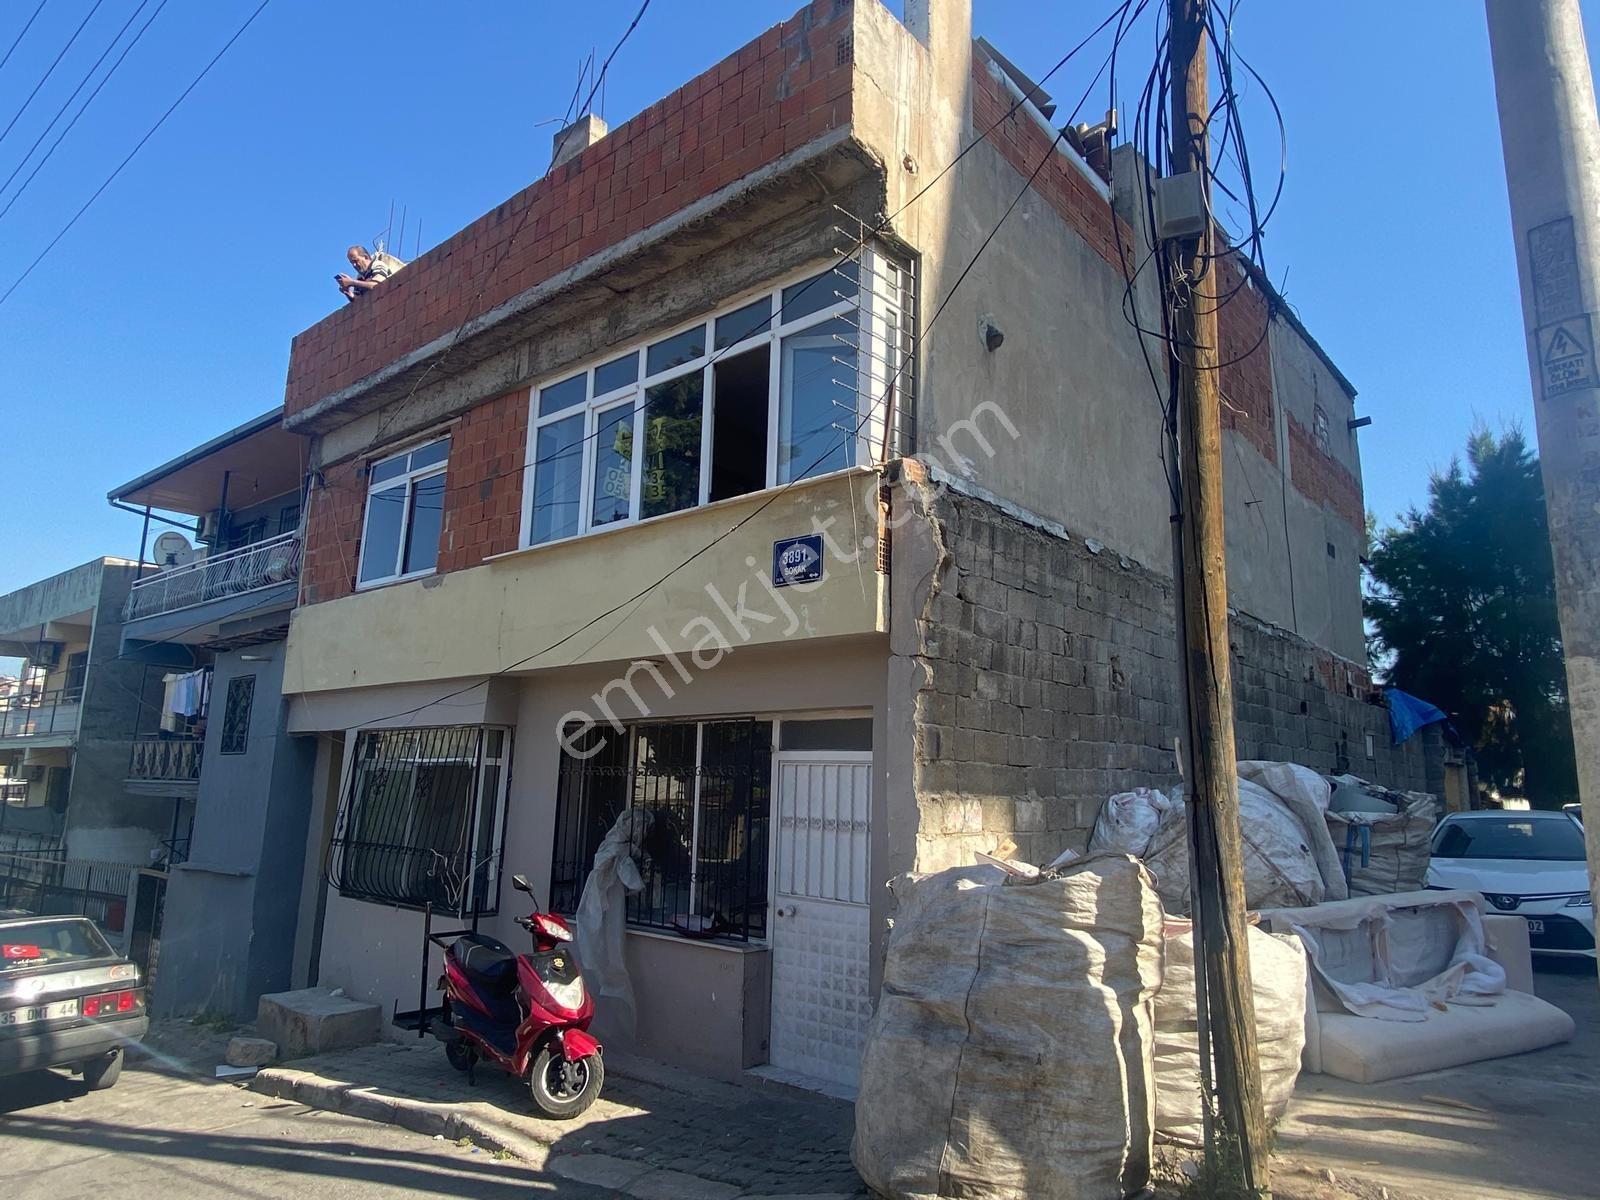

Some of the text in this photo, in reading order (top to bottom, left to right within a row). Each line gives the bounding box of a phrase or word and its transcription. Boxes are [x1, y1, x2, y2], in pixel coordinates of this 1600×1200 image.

[784, 565, 807, 576] SOKAK
[1, 1011, 17, 1025] 35
[60, 1002, 74, 1015] 44
